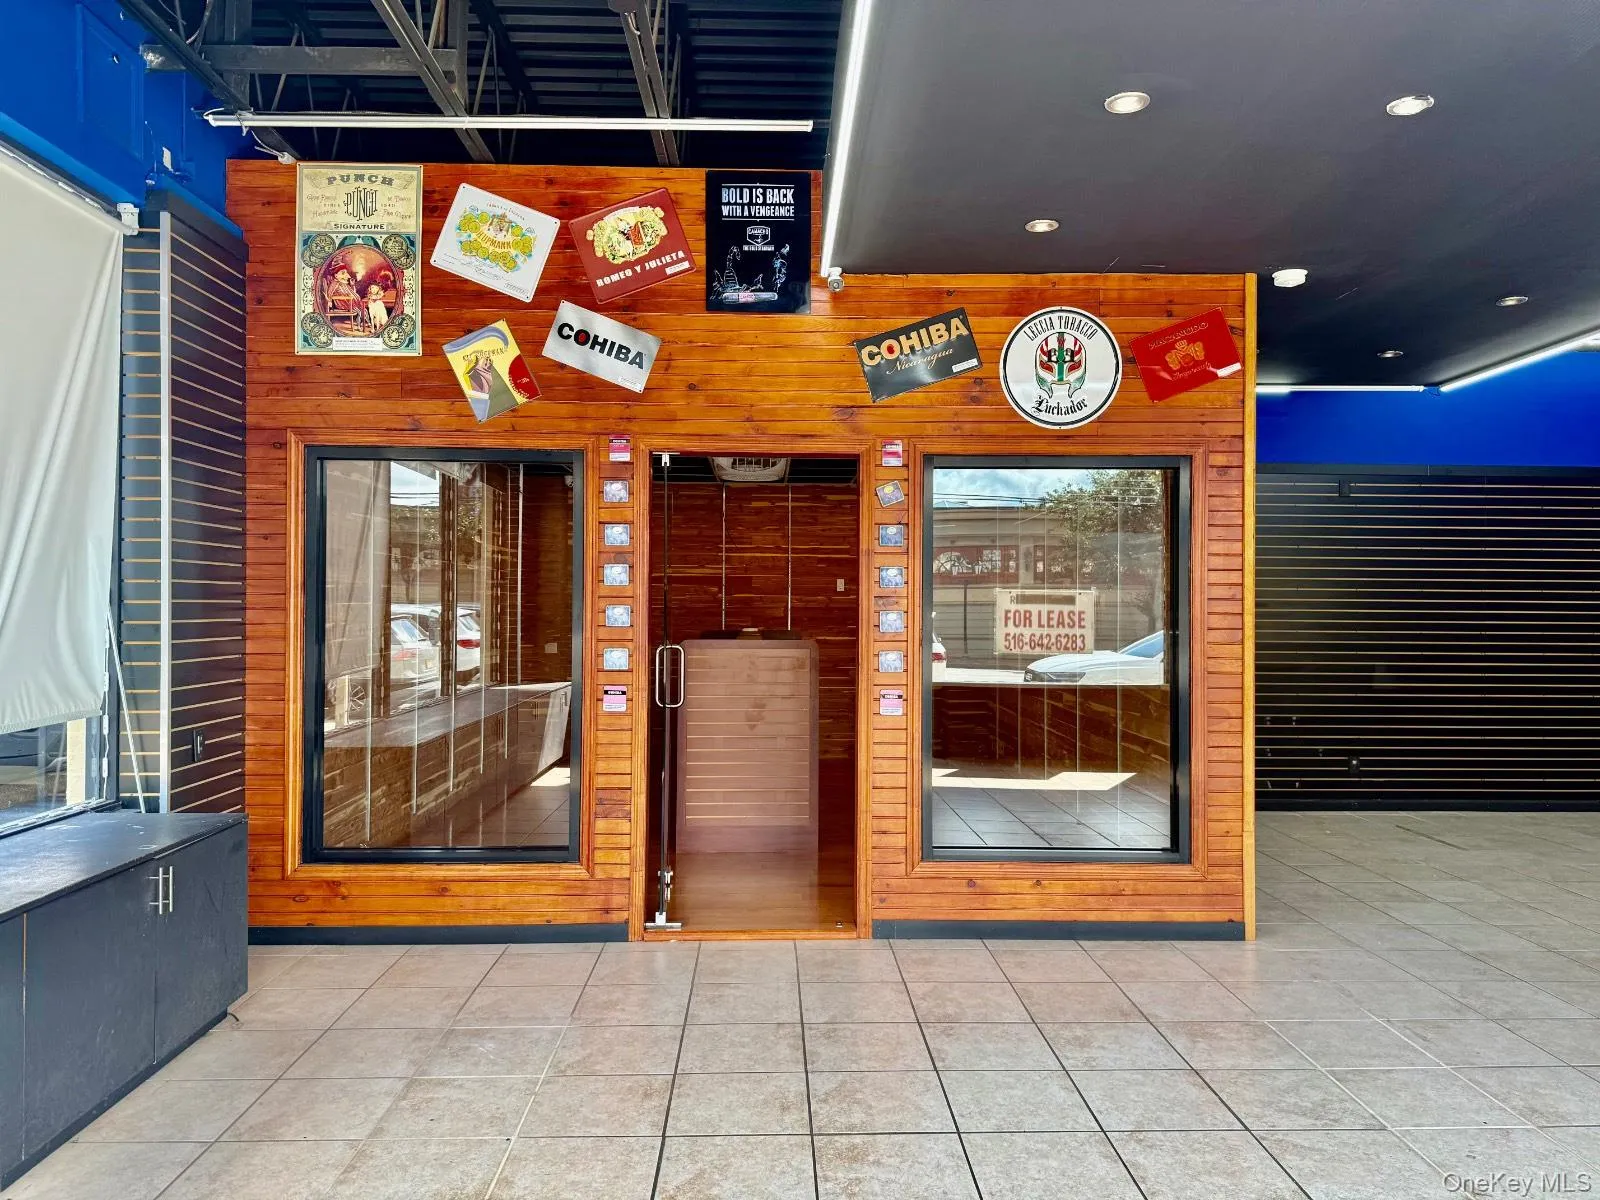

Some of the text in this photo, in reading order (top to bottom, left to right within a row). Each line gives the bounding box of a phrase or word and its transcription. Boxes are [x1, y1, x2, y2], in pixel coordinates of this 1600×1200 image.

[327, 173, 395, 187] PUNCH
[343, 186, 379, 222] PUNCH
[722, 187, 795, 204] BOLD IS BACK
[722, 205, 795, 217] WITH A VENGEANCE
[595, 268, 633, 287] ROMEO
[634, 264, 642, 273] Y
[644, 250, 686, 270] JULIETA
[1023, 315, 1099, 342] LECCIA TOBACCO
[557, 322, 645, 370] COHIBA
[861, 317, 969, 366] COHIBA
[886, 348, 953, 375] Nicaragua
[1031, 394, 1088, 417] Luchador
[1004, 609, 1086, 629] FOR LEASE
[1004, 632, 1086, 652] 516-642-6283
